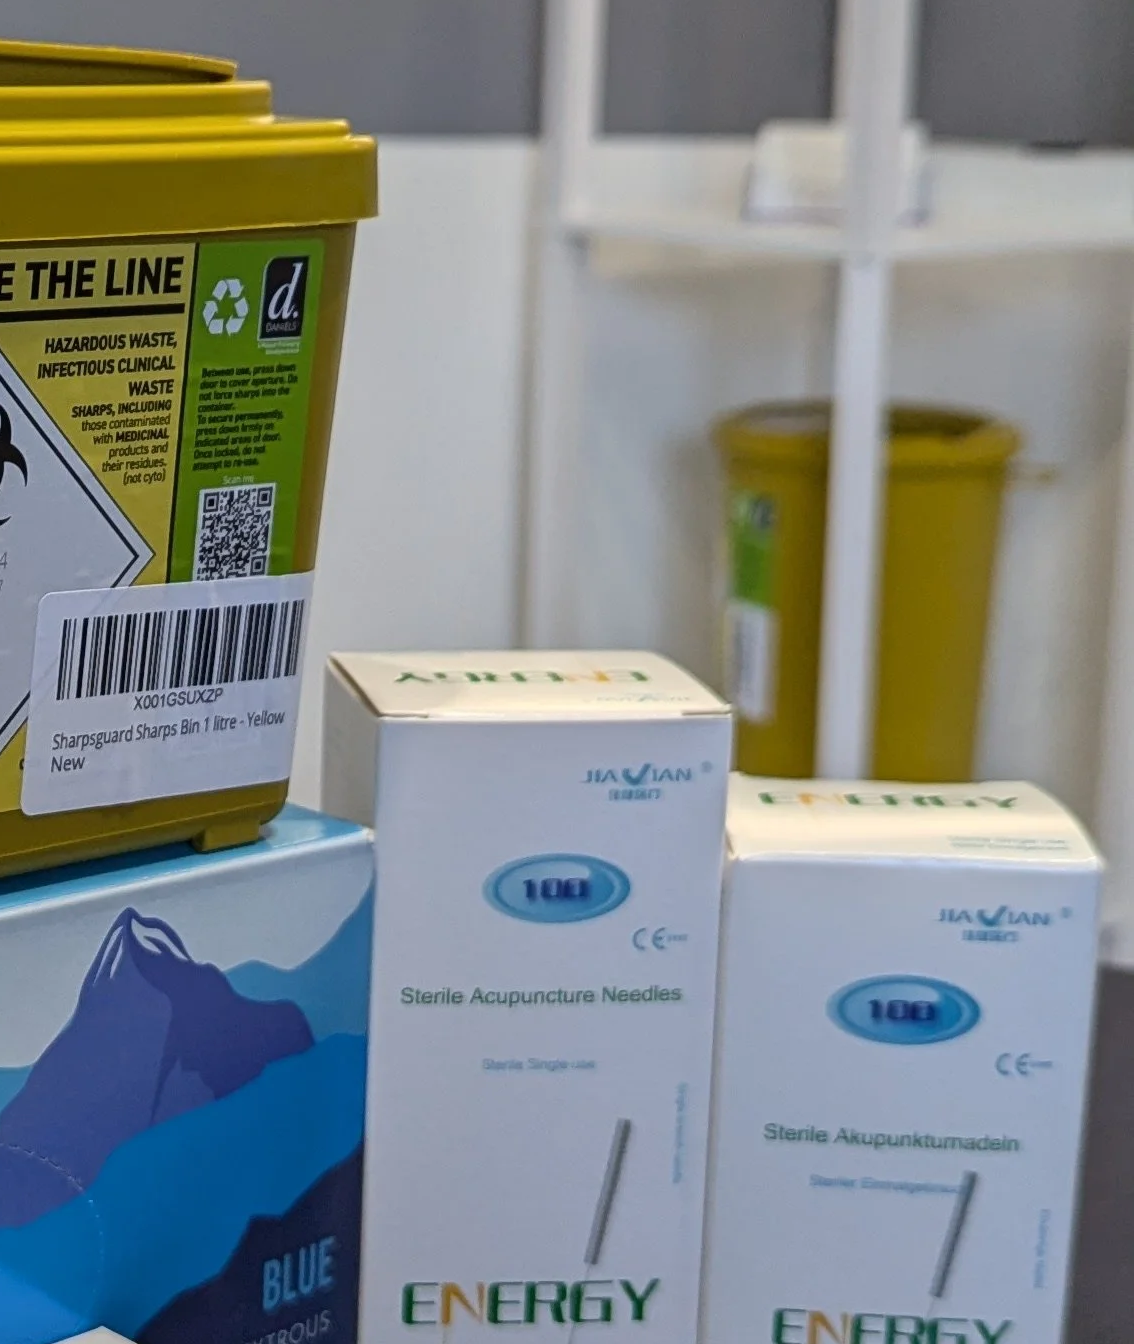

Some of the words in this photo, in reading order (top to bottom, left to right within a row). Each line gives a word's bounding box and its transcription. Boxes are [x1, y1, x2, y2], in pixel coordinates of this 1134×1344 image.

[25, 259, 96, 299] THE
[104, 256, 184, 296] LINE
[45, 334, 126, 354] HAZARDOUS
[129, 331, 177, 349] WASTE,
[37, 359, 115, 379] INFECTIOUS
[117, 355, 175, 373] CLINICAL
[128, 379, 174, 396] WASTE
[71, 403, 115, 418] SHARPS,
[118, 399, 172, 414] INCLUDING
[82, 418, 107, 432] those
[109, 414, 171, 429] contaminated
[93, 433, 113, 445] with
[115, 429, 169, 443] MEDICINAL
[109, 445, 149, 460] products
[151, 444, 168, 454] and
[101, 460, 124, 472] their
[133, 687, 223, 710] X001GSUXZP
[52, 724, 134, 751] Sharpsguard
[136, 720, 177, 741] Sharps
[180, 718, 199, 735] Bin
[203, 717, 210, 732] 1
[212, 714, 237, 731] litre
[247, 710, 286, 728] Yellow
[50, 755, 85, 773] New
[523, 875, 593, 903] 100
[400, 986, 463, 1006] Sterile
[470, 986, 595, 1010] Acupuncture
[602, 984, 683, 1004] Needles
[868, 998, 938, 1023] 100
[764, 1122, 828, 1144] Sterile
[262, 1236, 337, 1311] BLUE
[401, 1277, 660, 1326] ENERGY
